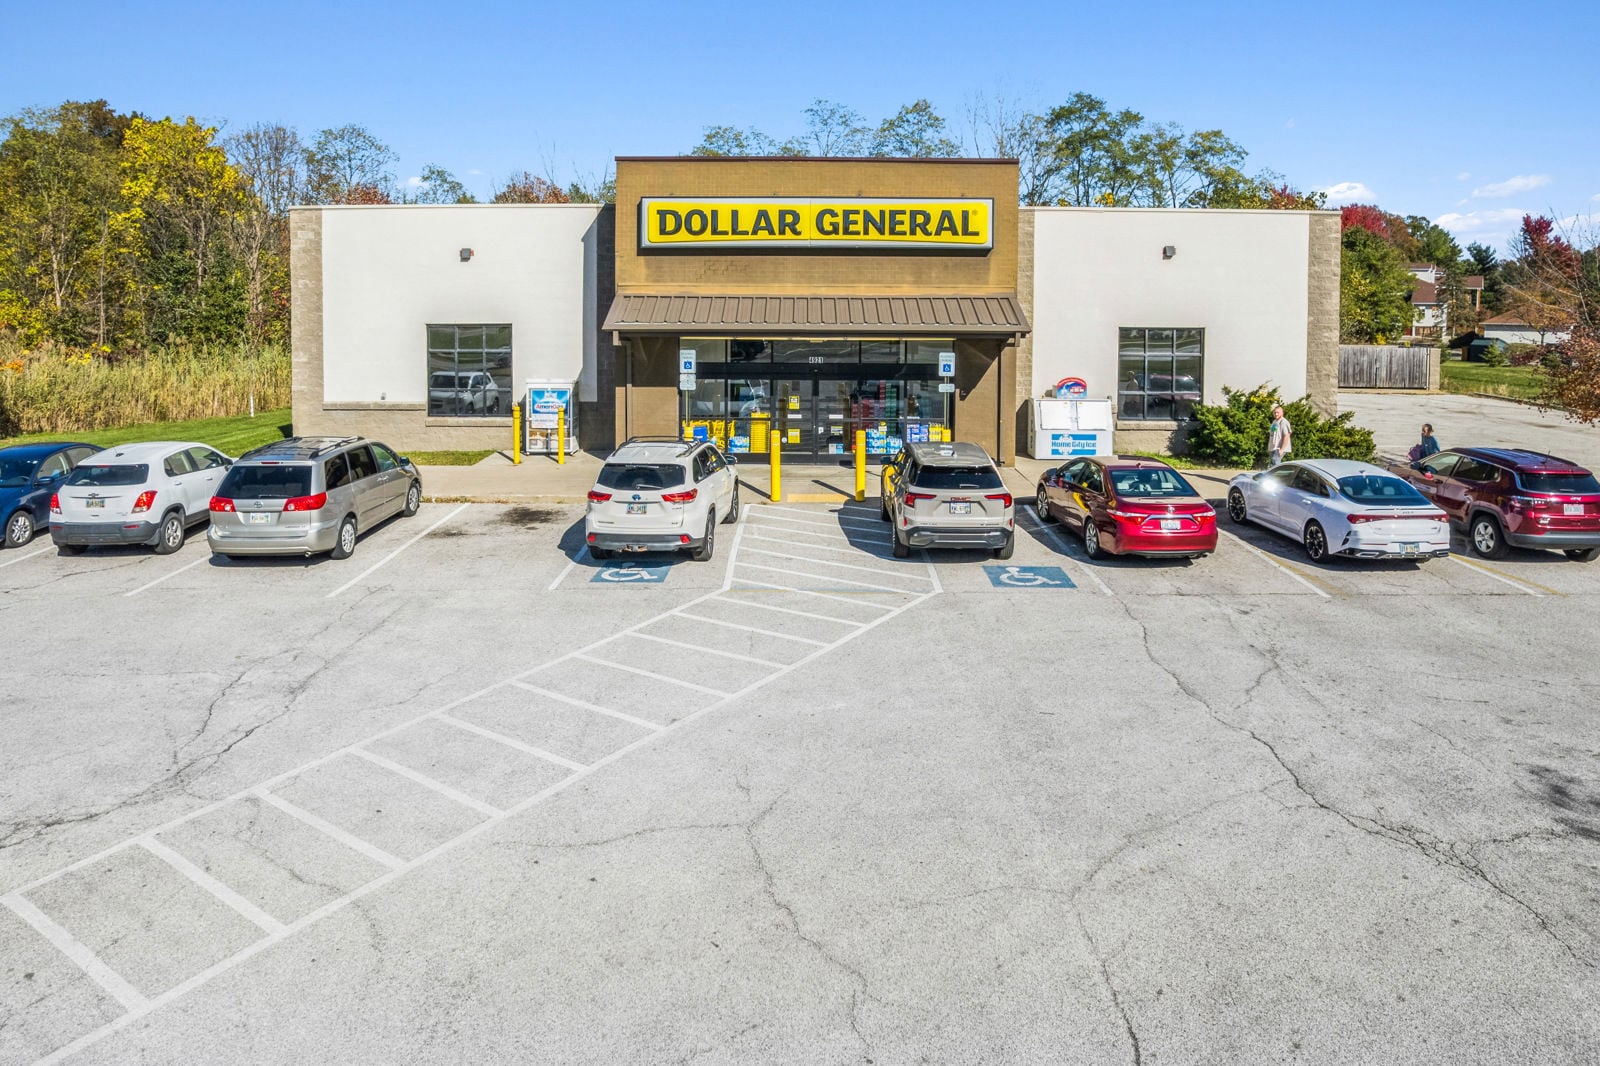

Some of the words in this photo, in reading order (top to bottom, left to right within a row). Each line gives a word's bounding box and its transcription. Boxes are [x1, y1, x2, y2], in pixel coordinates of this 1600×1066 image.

[656, 208, 802, 237] DOLLAR
[815, 208, 980, 237] GENERAL
[1051, 440, 1071, 448] Home
[1072, 440, 1085, 449] City
[1085, 440, 1097, 448] Ice
